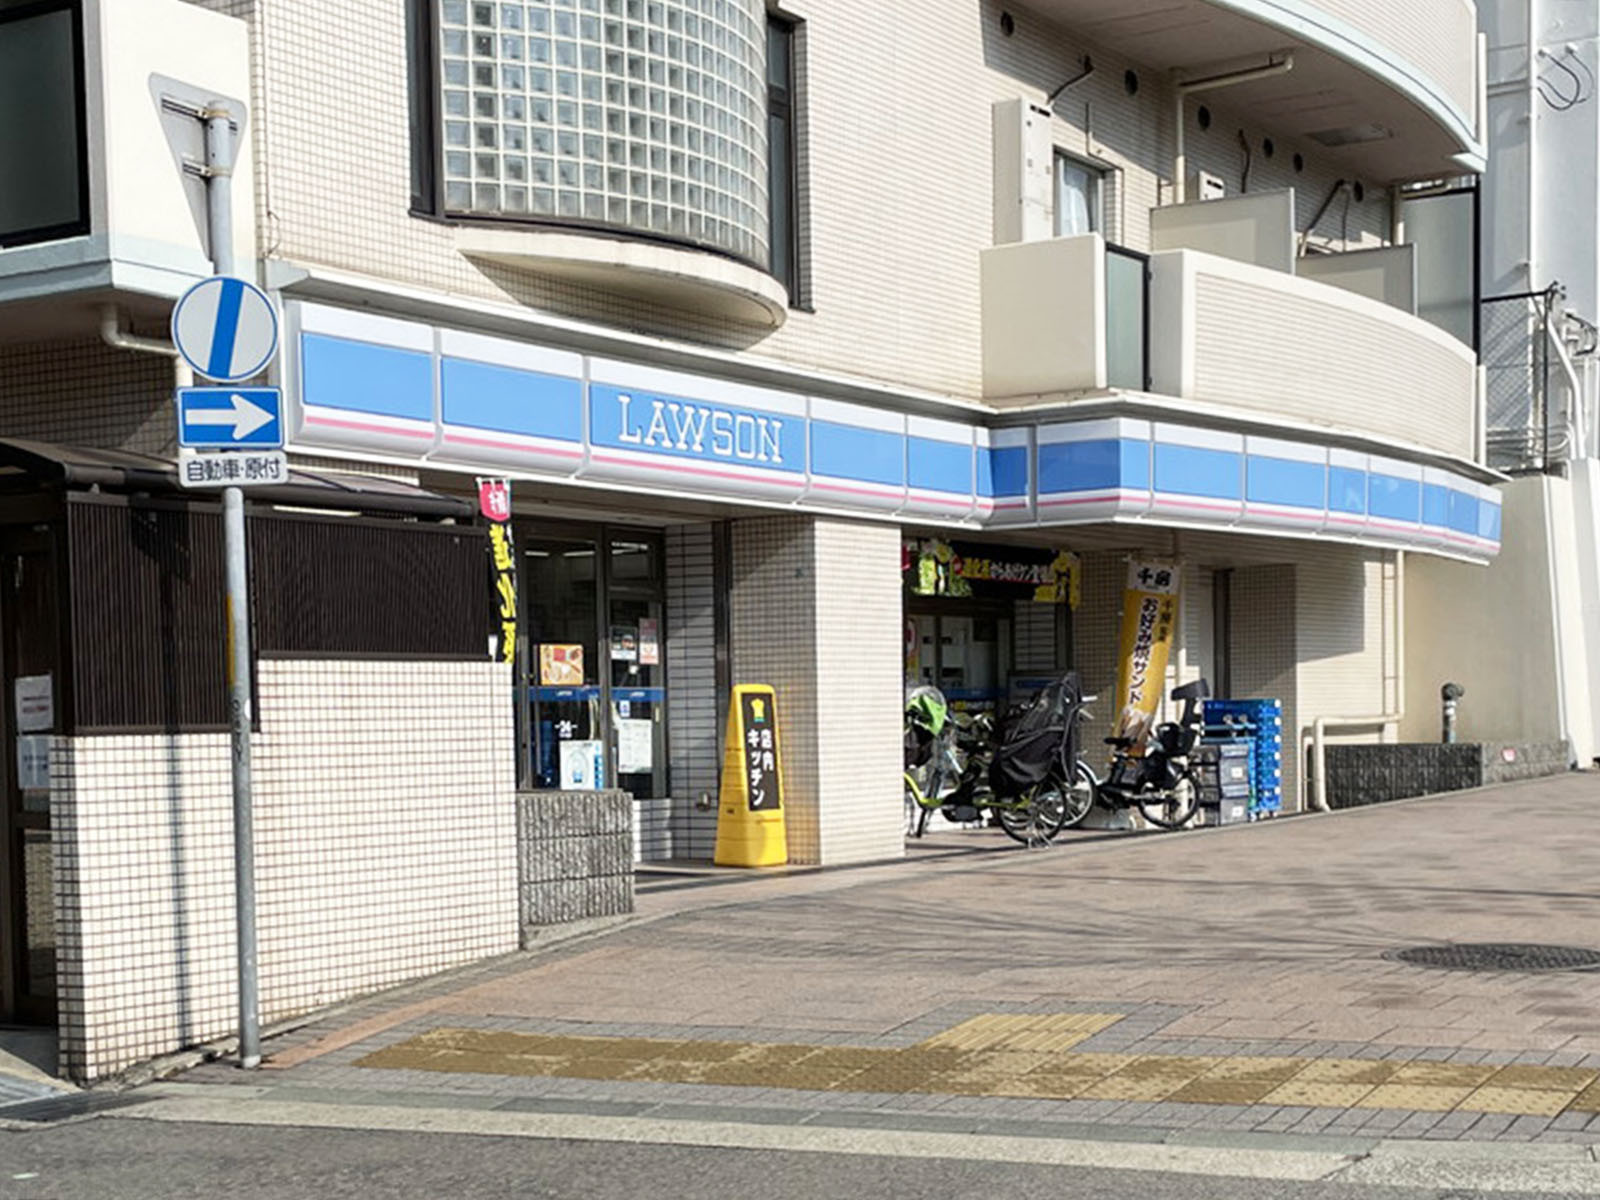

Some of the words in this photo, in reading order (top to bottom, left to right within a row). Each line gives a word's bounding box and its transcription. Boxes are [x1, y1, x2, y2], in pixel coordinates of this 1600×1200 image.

[617, 394, 784, 463] LAWSON
[747, 728, 766, 807] キッチン
[760, 728, 775, 772] 店内
